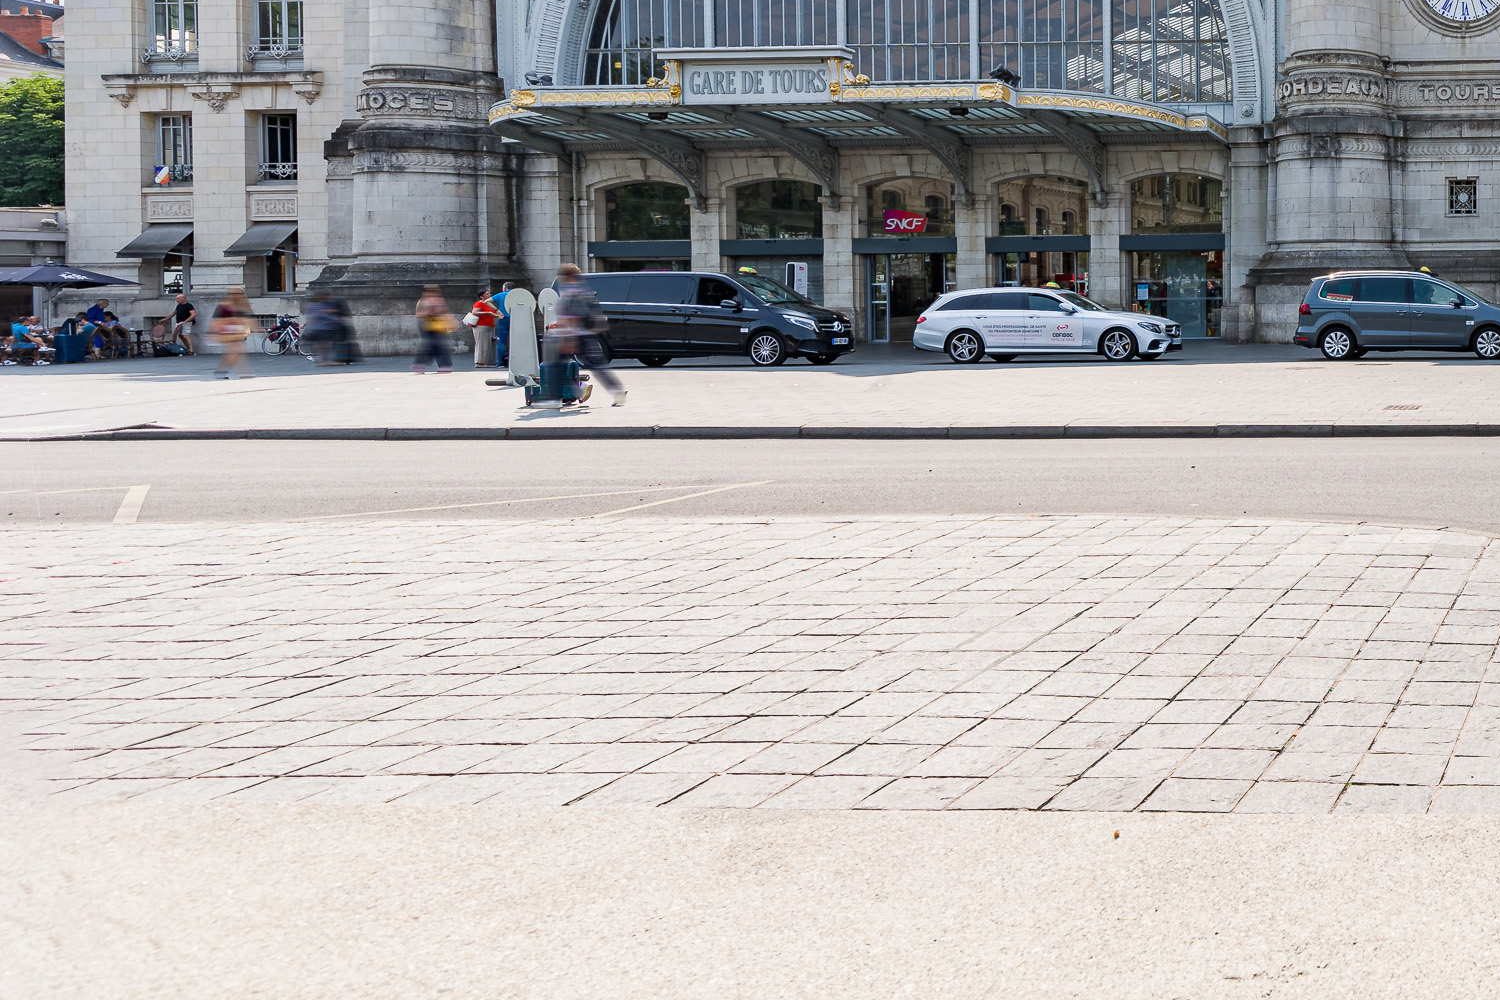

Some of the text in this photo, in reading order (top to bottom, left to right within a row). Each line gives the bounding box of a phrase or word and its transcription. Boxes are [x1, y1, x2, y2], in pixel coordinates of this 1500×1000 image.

[689, 69, 827, 95] GARE DE TOURS
[885, 217, 924, 230] SNCF
